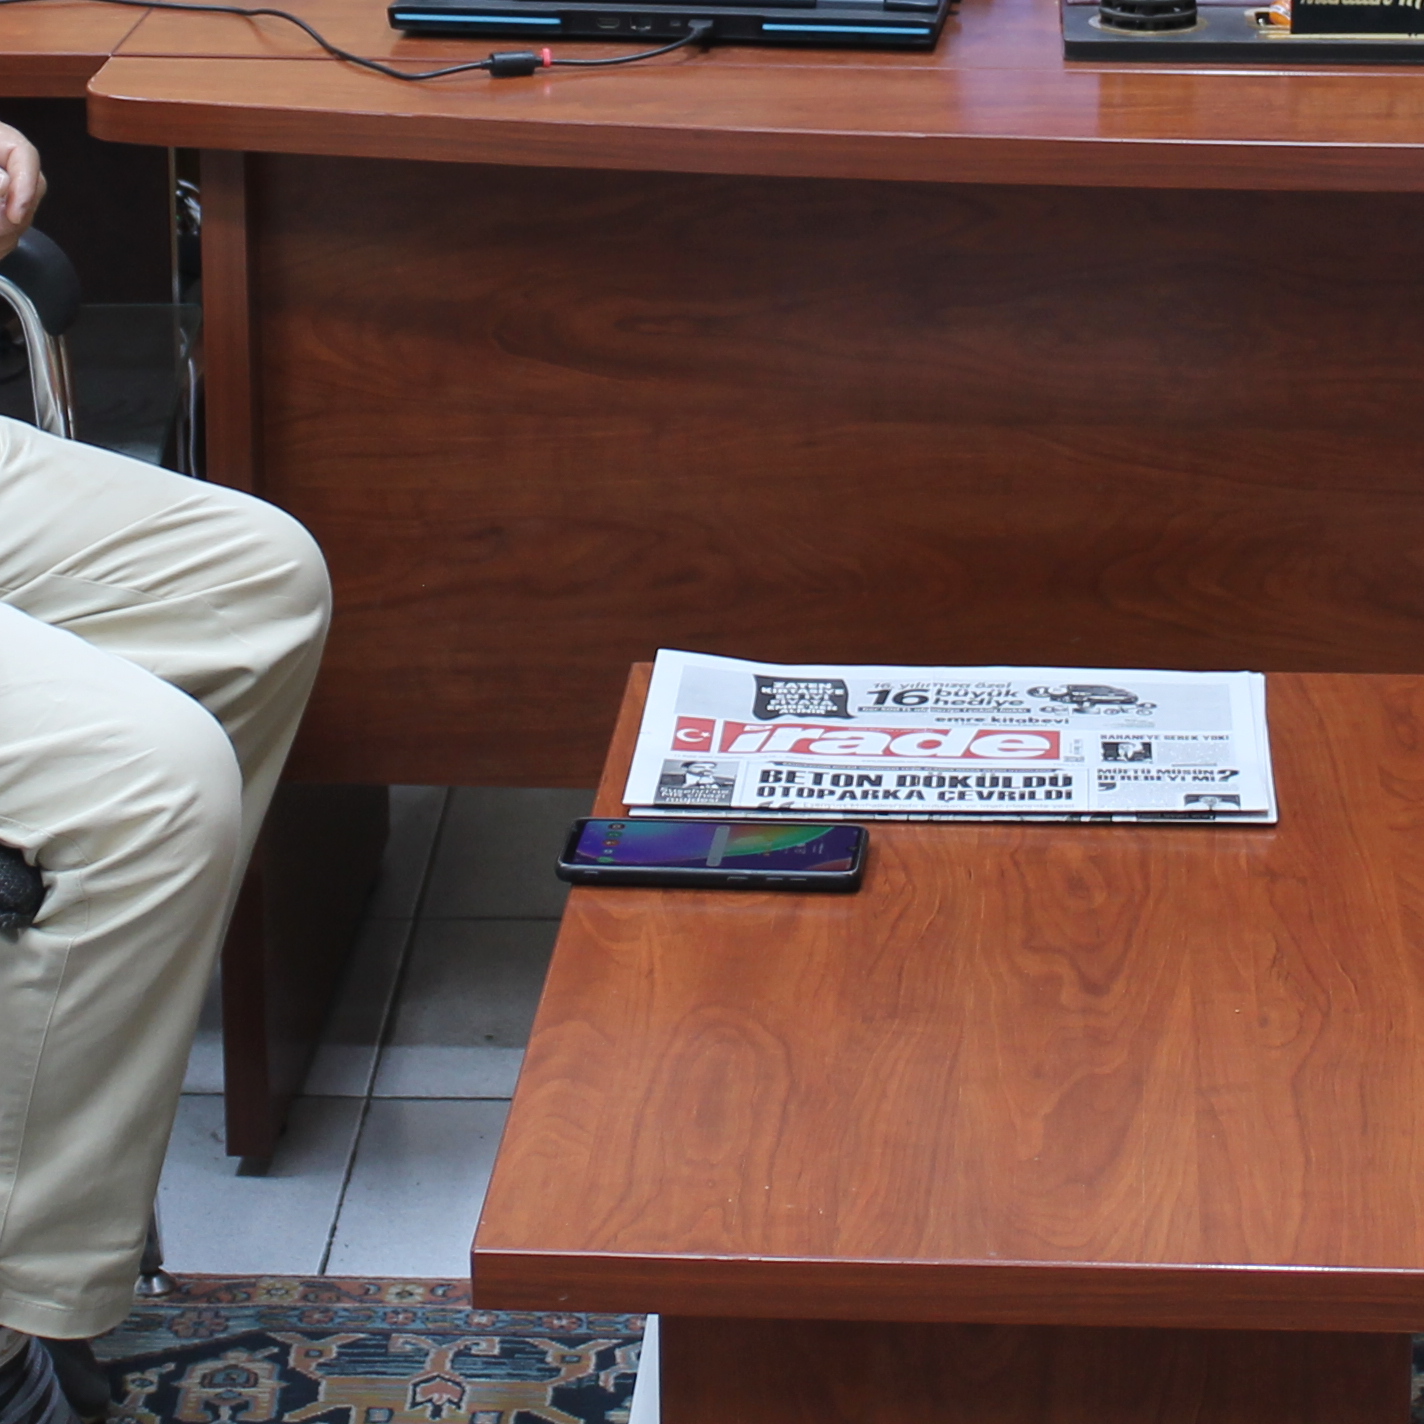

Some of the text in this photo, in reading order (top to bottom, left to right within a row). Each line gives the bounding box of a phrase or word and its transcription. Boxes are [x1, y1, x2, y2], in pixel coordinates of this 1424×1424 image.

[866, 687, 1020, 707] 16 büyük
[932, 696, 1025, 709] hediye
[934, 715, 1070, 725] emre kitabevi
[727, 724, 1051, 758] irade
[758, 769, 1073, 789] BETON DÖKÜLDÜ
[756, 785, 1073, 803] OTOPARKA ÇEVRİLDİ
